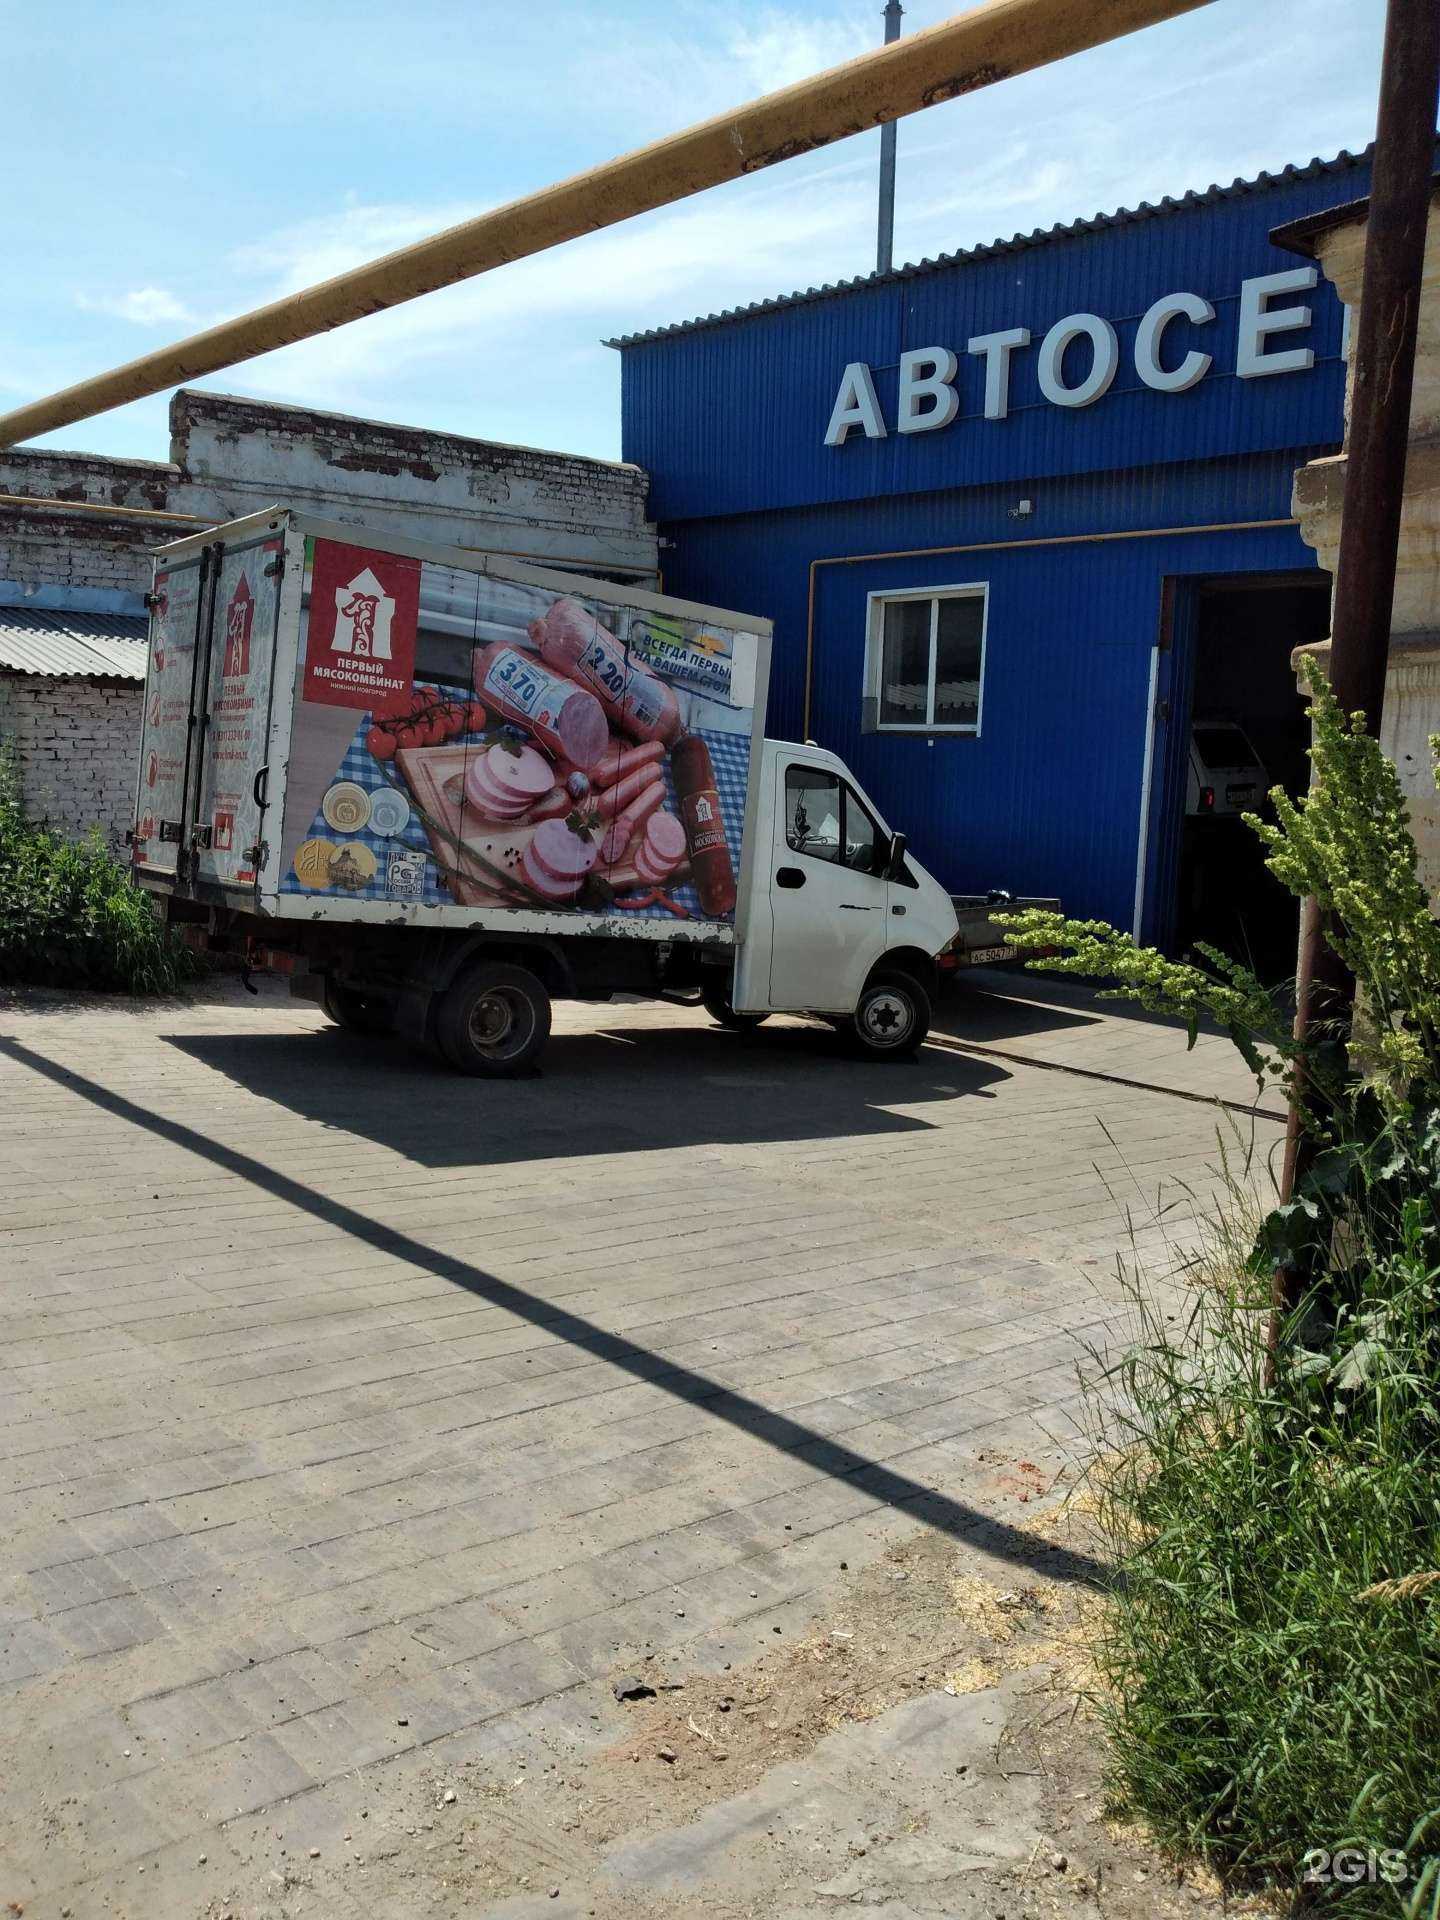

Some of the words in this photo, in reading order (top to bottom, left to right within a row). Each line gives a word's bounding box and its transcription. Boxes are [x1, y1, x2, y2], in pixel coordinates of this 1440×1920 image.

[824, 266, 1350, 446] АВТОСЕ
[643, 634, 687, 661] ВСЕГДА
[313, 666, 405, 690] МЯСОКОМБИНАТ
[337, 657, 384, 675] ПЕРВЫЙ
[634, 651, 651, 665] НА
[652, 656, 698, 681] ВАШЕМ
[330, 682, 357, 692] НИЖНИЙ
[357, 686, 387, 697] НОВГОРОД
